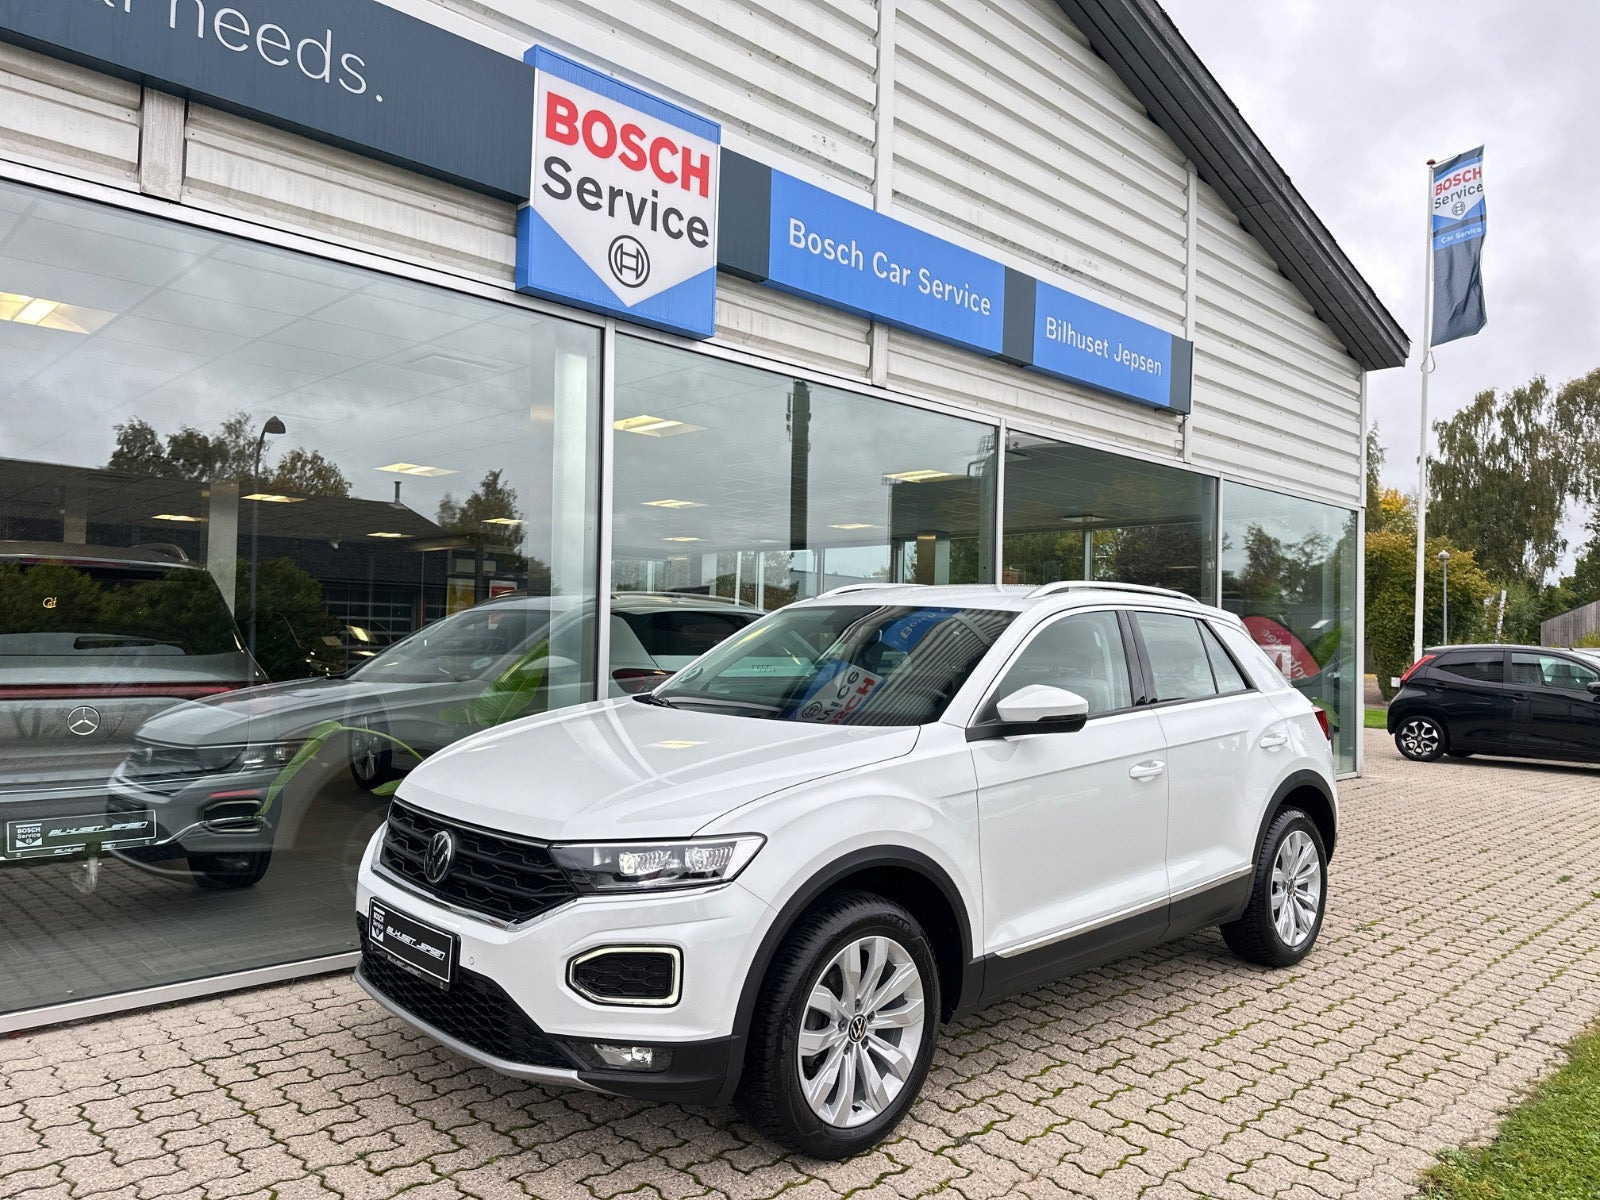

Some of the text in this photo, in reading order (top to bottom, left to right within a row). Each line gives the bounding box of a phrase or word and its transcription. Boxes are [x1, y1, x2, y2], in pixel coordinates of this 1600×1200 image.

[169, 0, 383, 102] needs.
[545, 91, 710, 199] BOSCH
[541, 156, 709, 248] Service
[1434, 183, 1483, 209] Service
[1435, 165, 1482, 196] BOSCH
[788, 217, 991, 316] Bosch Car Service
[1440, 227, 1482, 244] Car Service
[1046, 315, 1162, 377] Bilhuset Jepsen
[16, 826, 41, 834] BOSCH
